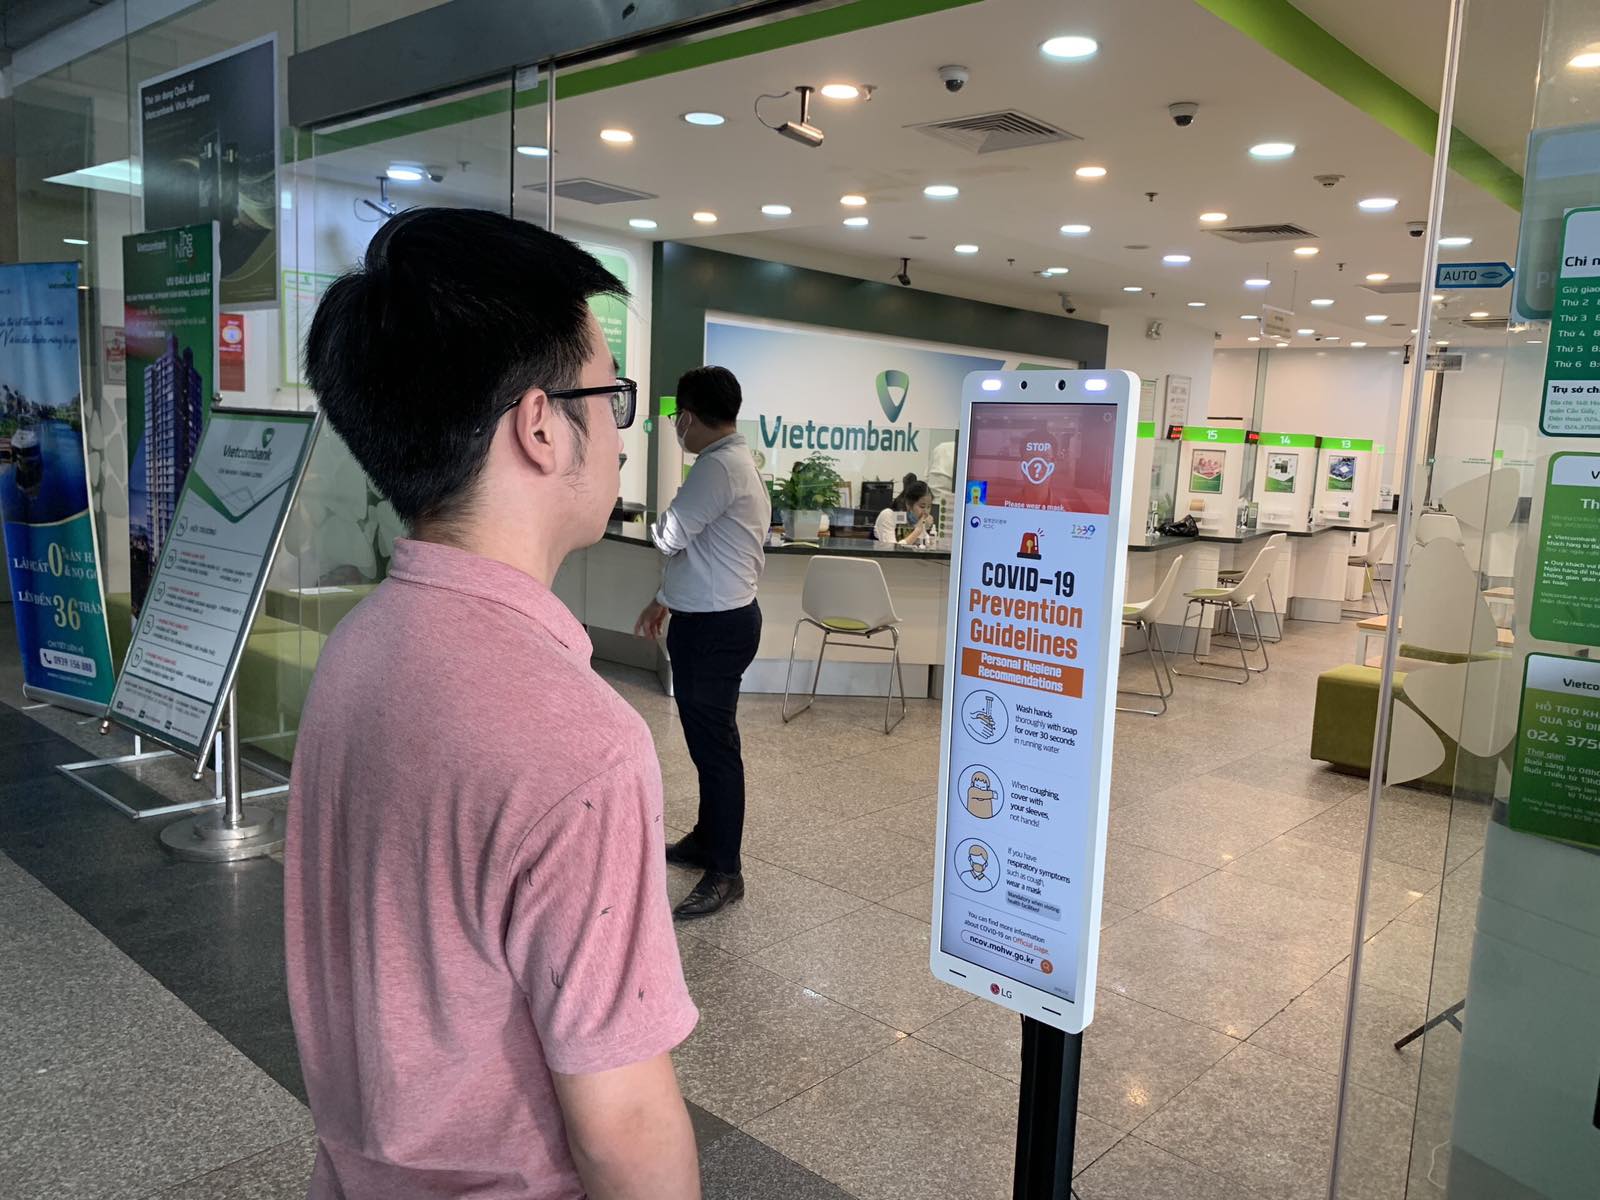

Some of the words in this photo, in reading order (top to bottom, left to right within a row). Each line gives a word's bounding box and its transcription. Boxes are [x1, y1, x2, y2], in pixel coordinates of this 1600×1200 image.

[1565, 256, 1588, 268] Chi
[1443, 270, 1478, 282] AUTO
[1562, 286, 1579, 295] Giờ
[1561, 298, 1579, 307] Thứ
[1560, 314, 1578, 322] Thứ
[1558, 330, 1576, 338] Thứ
[1556, 345, 1574, 353] Thứ
[1576, 345, 1584, 353] 5
[1554, 360, 1572, 369] Thứ
[1551, 385, 1568, 395] Trụ
[1571, 384, 1584, 394] sở
[759, 414, 920, 452] Vietcombank
[1207, 430, 1218, 440] 15
[1026, 442, 1052, 452] STOP
[1280, 436, 1291, 445] 14
[1341, 440, 1352, 449] 13
[223, 444, 272, 462] Vietcombank
[1005, 500, 1025, 509] Please
[1071, 524, 1096, 536] 1339
[1547, 540, 1565, 548] khách
[1554, 534, 1596, 544] Vietcombank
[982, 562, 1075, 598] COVID-19
[53, 595, 81, 631] 36
[969, 588, 1083, 629] Prevention
[970, 618, 1078, 660] Guidelines
[981, 654, 1021, 671] Personal
[1023, 661, 1062, 679] Hygiene
[978, 667, 1063, 693] Recommendations
[1563, 677, 1600, 692] Vietco
[1015, 703, 1033, 714] Wash
[1034, 707, 1053, 719] hands
[1015, 715, 1046, 730] thoroughly
[1047, 722, 1061, 732] with
[1062, 726, 1078, 737] soap
[1539, 715, 1563, 727] QUA
[1014, 725, 1024, 734] for
[1024, 728, 1038, 738] over
[1039, 731, 1049, 740] 30
[1049, 734, 1076, 747] seconds
[1527, 729, 1560, 744] 024
[1020, 739, 1042, 751] running
[1043, 744, 1060, 754] water
[1524, 757, 1543, 767] Buổi
[1545, 761, 1564, 772] sáng
[1523, 766, 1542, 776] Buổi
[1544, 770, 1566, 781] chiều
[1011, 779, 1029, 792] When
[1010, 792, 1029, 802] cover
[1029, 797, 1044, 807] with
[1009, 812, 1020, 822] not
[1010, 802, 1025, 813] your
[1025, 806, 1050, 821] sleeves,
[1012, 850, 1023, 858] you
[1023, 852, 1037, 863] have
[1006, 868, 1019, 878] such
[1007, 858, 1039, 875] respiratory
[1038, 868, 1071, 884] symptoms
[1006, 879, 1020, 889] wear
[967, 910, 978, 920] You
[978, 915, 988, 923] can
[988, 917, 999, 928] find
[1000, 923, 1014, 932] more
[1014, 926, 1046, 945] information
[964, 919, 979, 930] about
[979, 923, 1004, 939] COVID-19
[1004, 934, 1012, 942] on
[1012, 935, 1033, 950] Official
[969, 934, 1035, 966] ncov.mohw.go.kr
[1001, 988, 1013, 1000] LG
